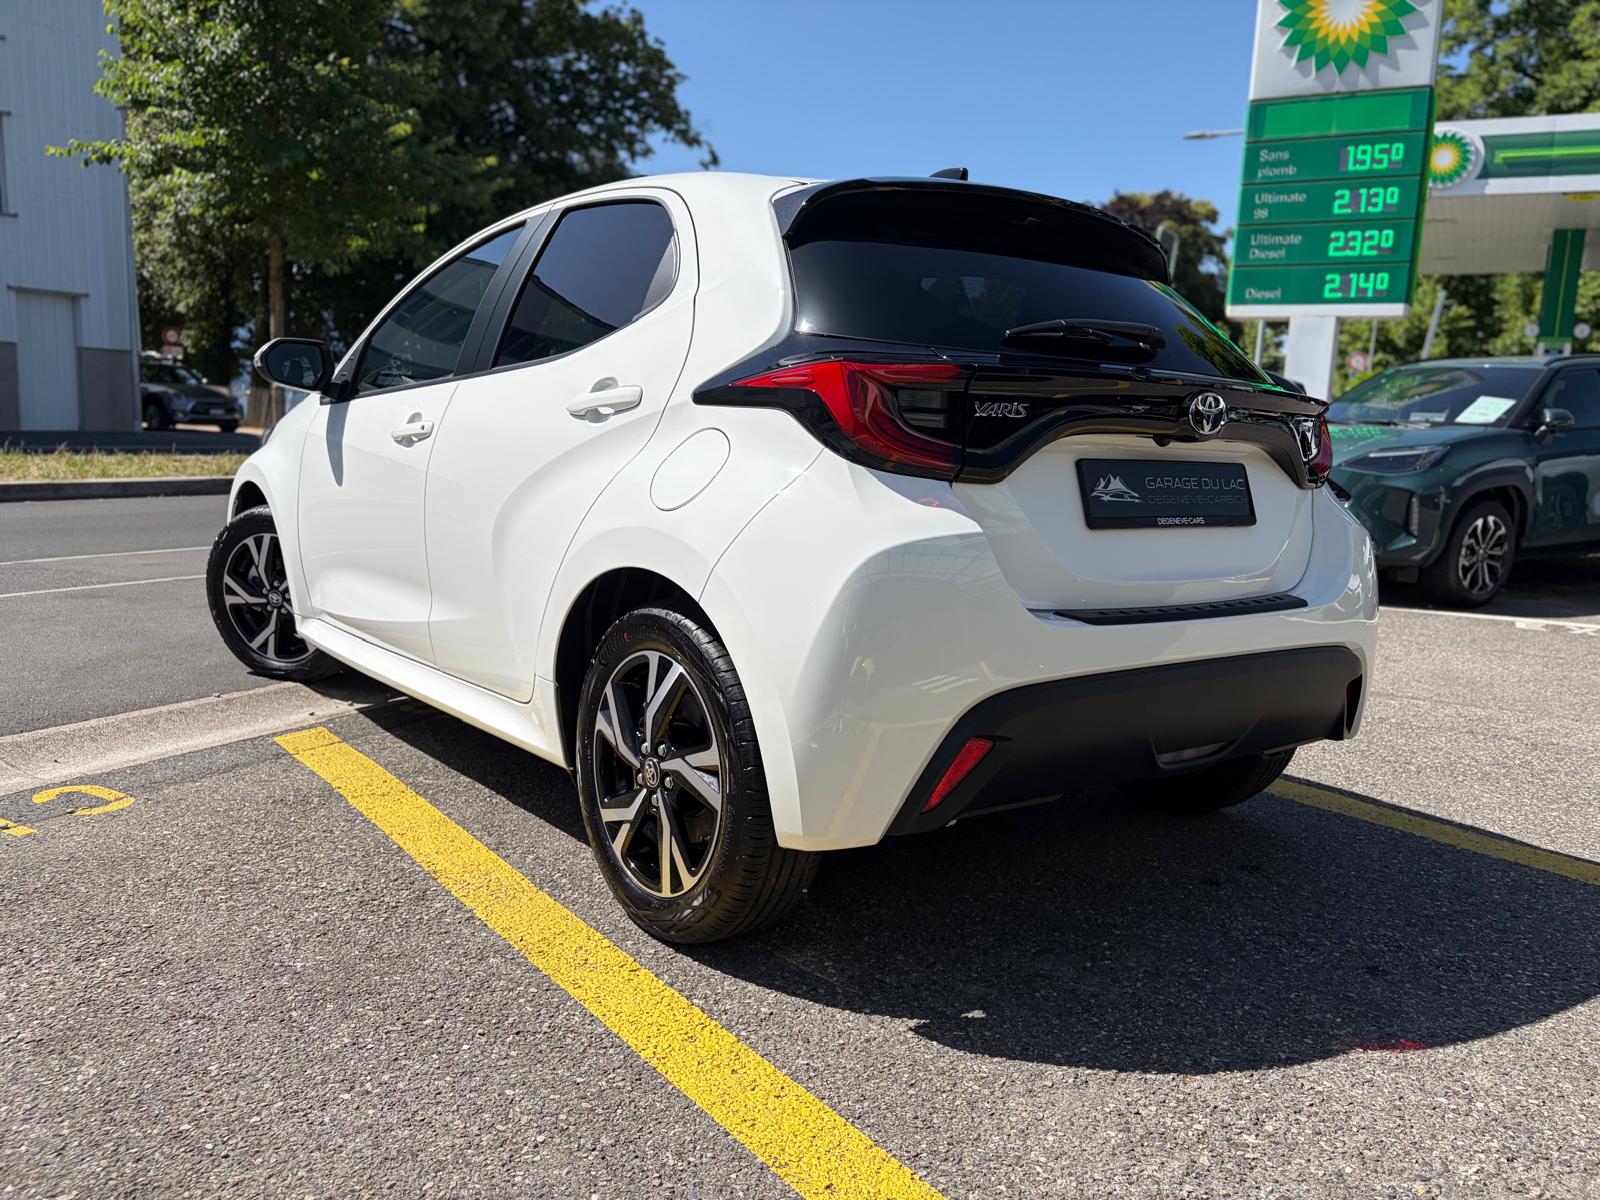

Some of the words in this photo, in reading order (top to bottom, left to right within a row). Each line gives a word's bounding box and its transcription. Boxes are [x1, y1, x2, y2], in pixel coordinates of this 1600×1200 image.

[1259, 149, 1290, 162] Sans
[1257, 165, 1297, 179] plomb
[1254, 192, 1307, 204] Ultimate
[1253, 207, 1269, 219] 98
[1250, 233, 1302, 245] Ultimate
[1248, 248, 1286, 260] Diesel
[1244, 287, 1282, 300] Diesel
[1145, 477, 1199, 489] GARAGE
[1201, 477, 1219, 489] DU
[1222, 478, 1245, 490] LAC
